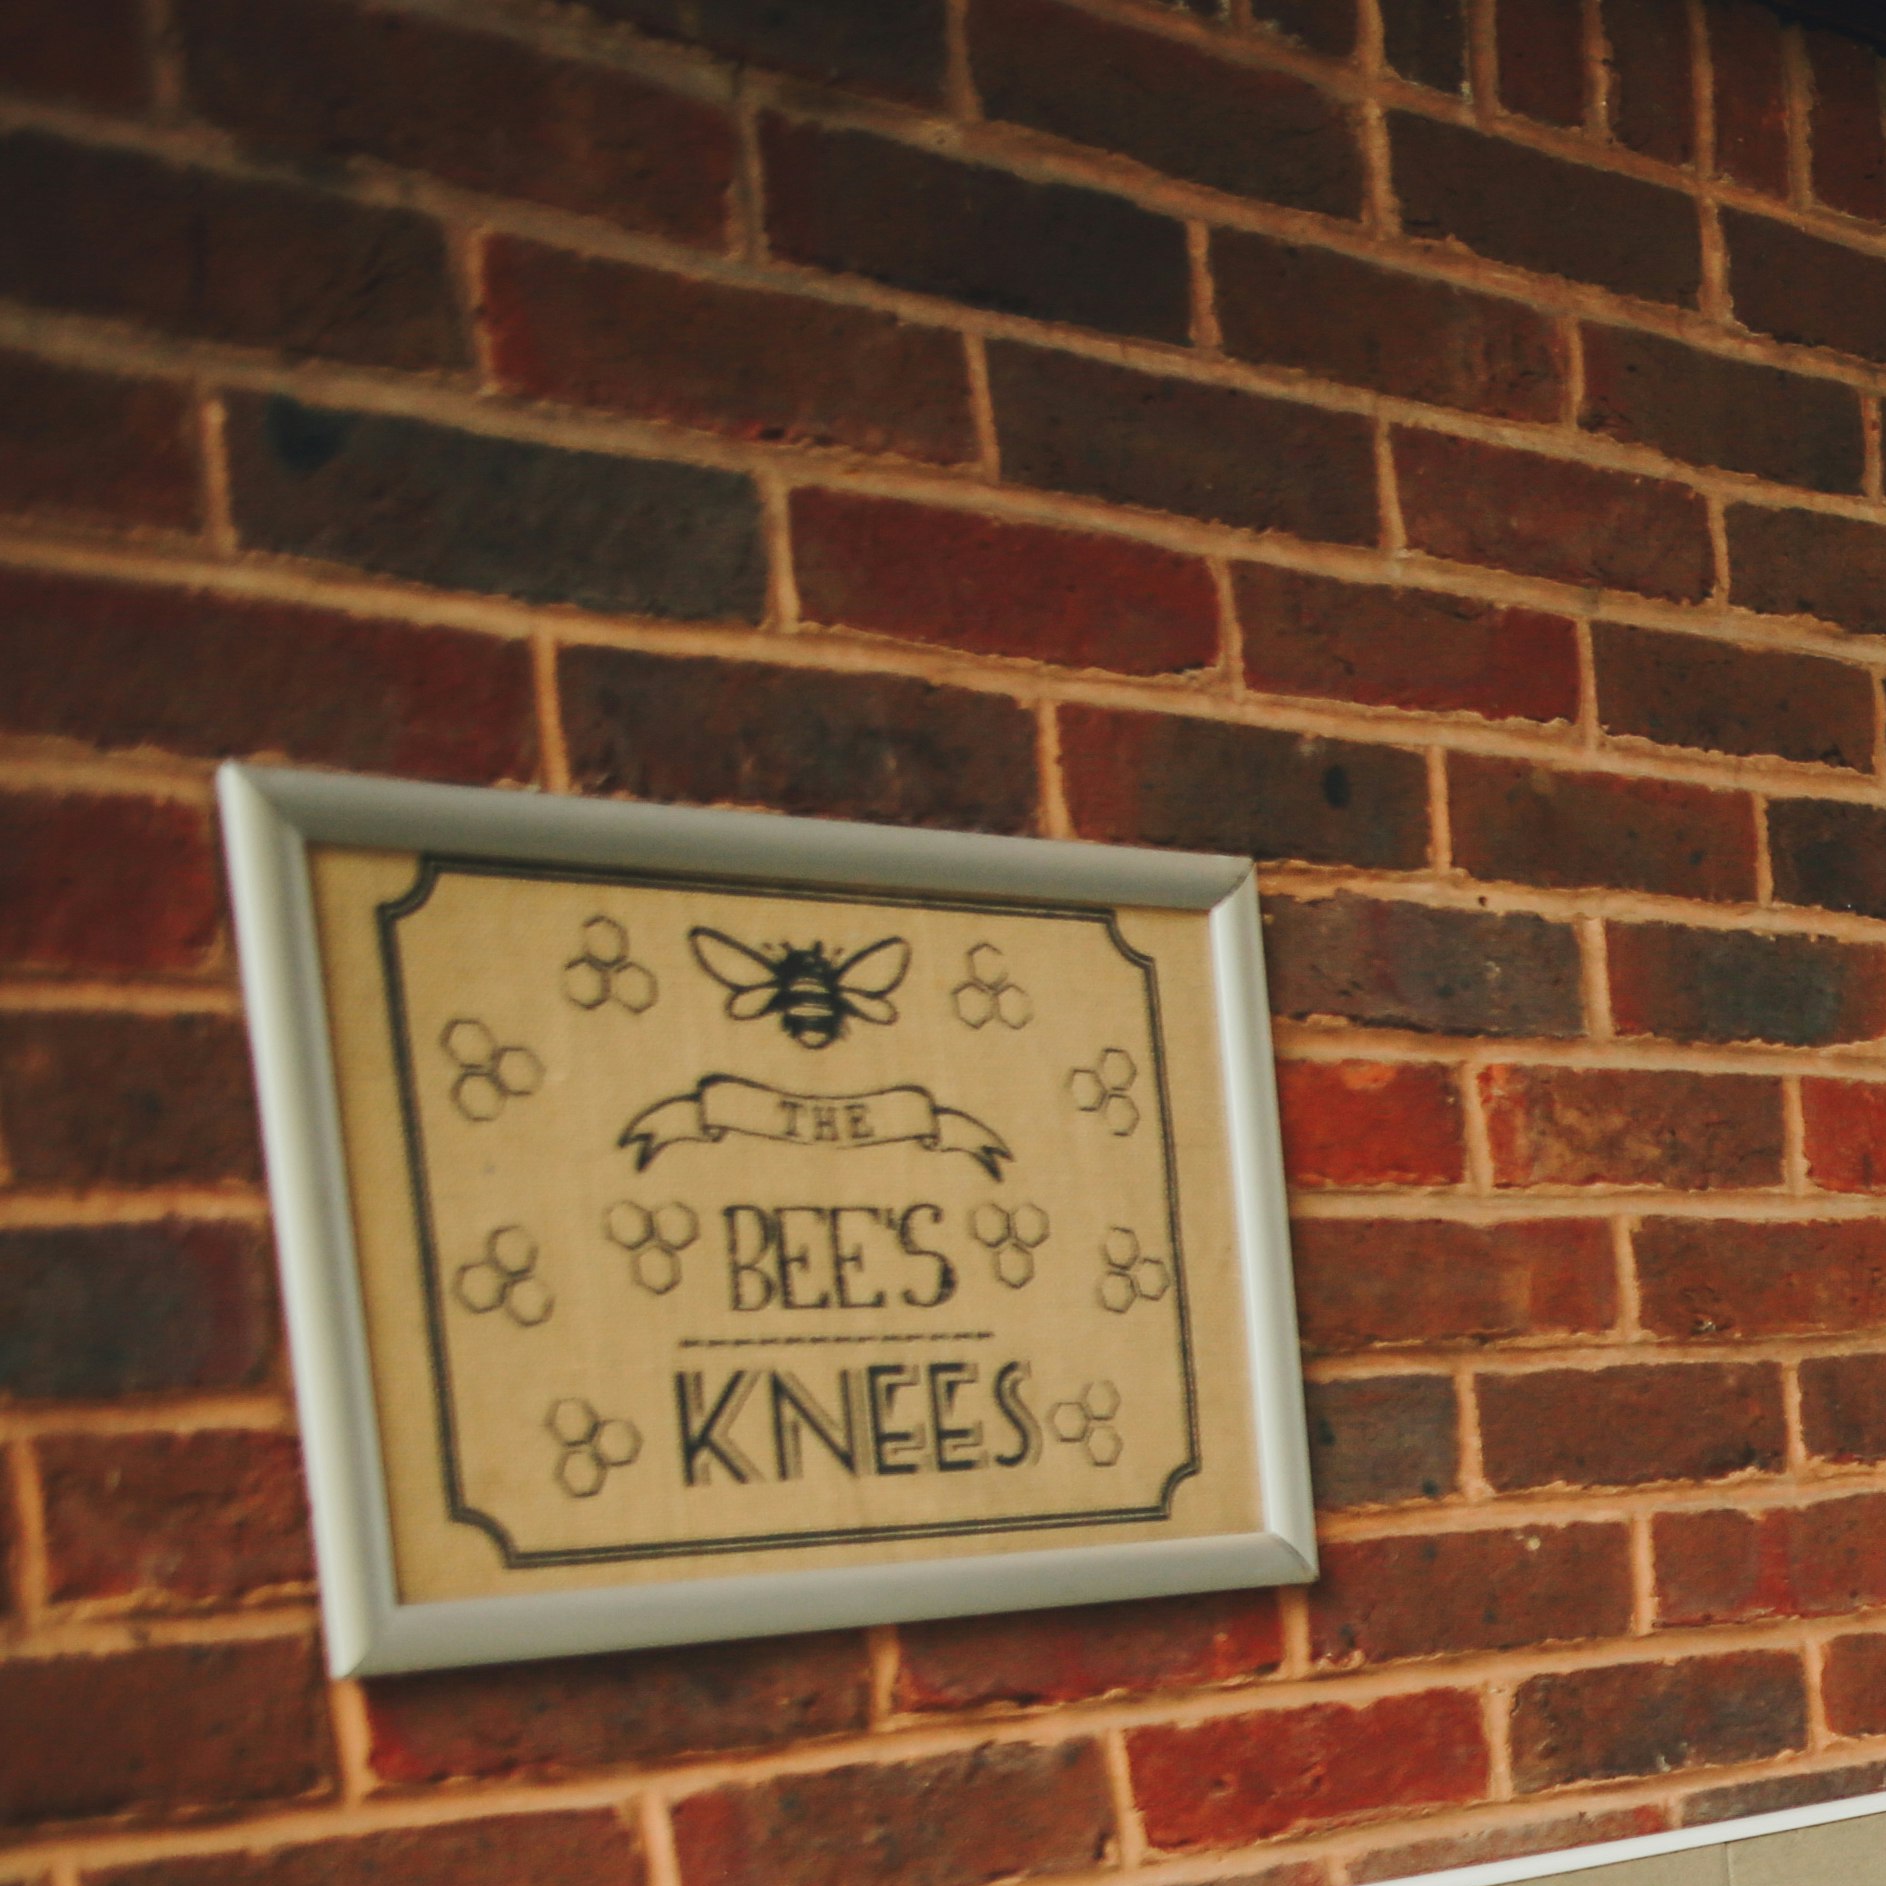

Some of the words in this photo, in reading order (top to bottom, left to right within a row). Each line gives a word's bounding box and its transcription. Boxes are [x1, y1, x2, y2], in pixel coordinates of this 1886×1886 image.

[780, 1099, 875, 1142] THE
[722, 1203, 959, 1312] BEE'S
[675, 1361, 1043, 1487] KNEES
